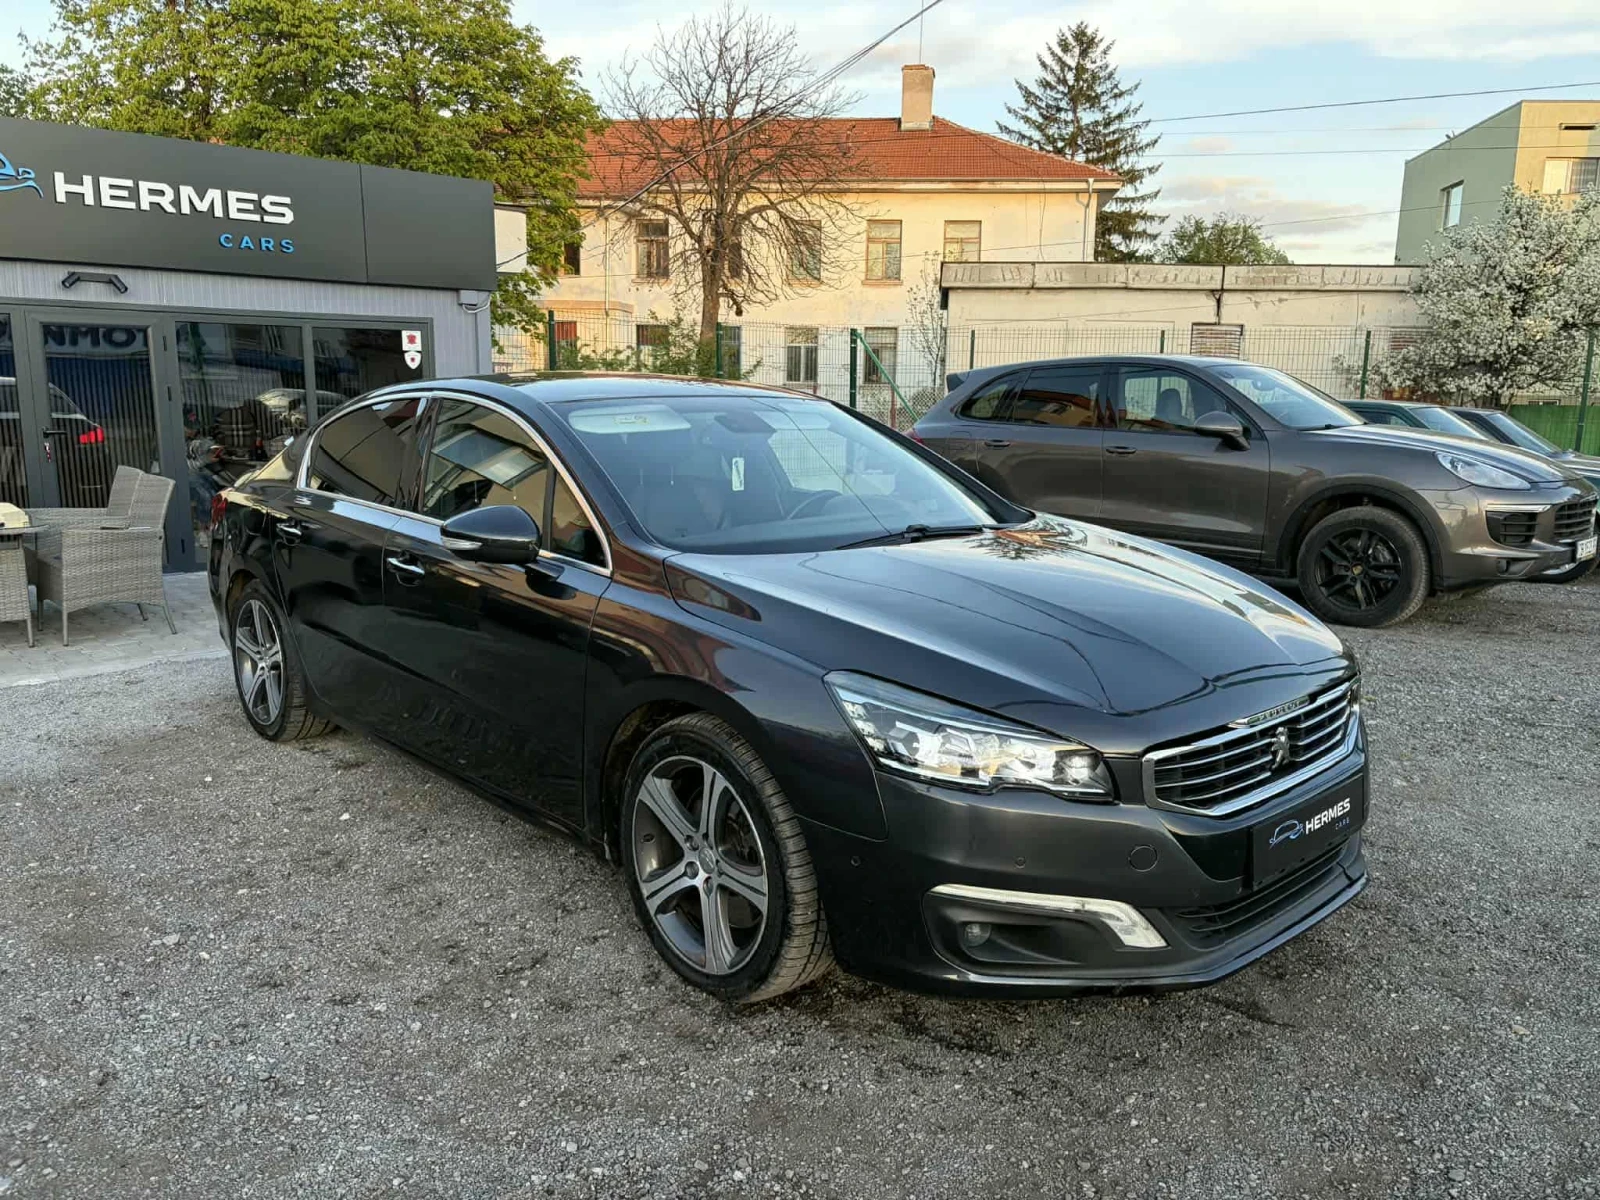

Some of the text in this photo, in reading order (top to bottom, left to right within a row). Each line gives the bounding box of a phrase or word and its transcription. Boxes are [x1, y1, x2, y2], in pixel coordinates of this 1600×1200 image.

[53, 171, 295, 225] HERMES
[218, 233, 295, 254] CARS
[1305, 797, 1351, 835] HERMES
